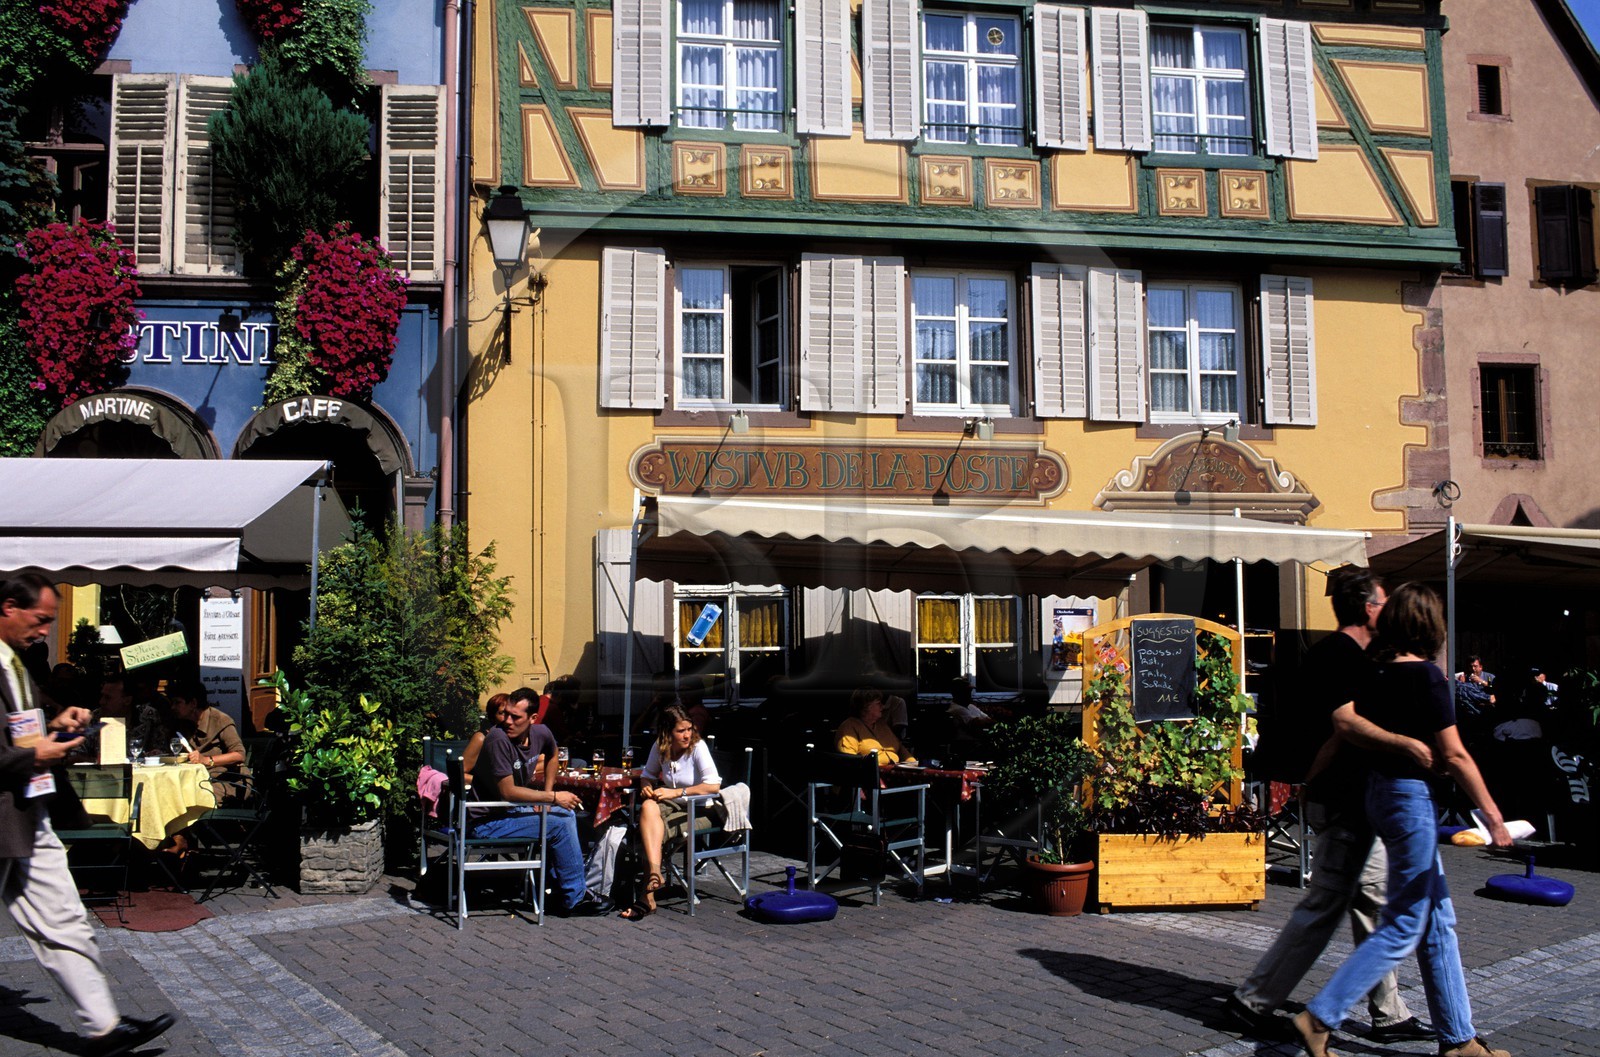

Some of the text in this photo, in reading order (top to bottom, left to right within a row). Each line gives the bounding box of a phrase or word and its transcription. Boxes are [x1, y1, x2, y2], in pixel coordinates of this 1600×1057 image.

[79, 397, 154, 420] MARTINE
[283, 398, 343, 421] CAFE
[817, 452, 865, 490] DE
[868, 453, 915, 491] LA
[919, 453, 1031, 492] POSTE
